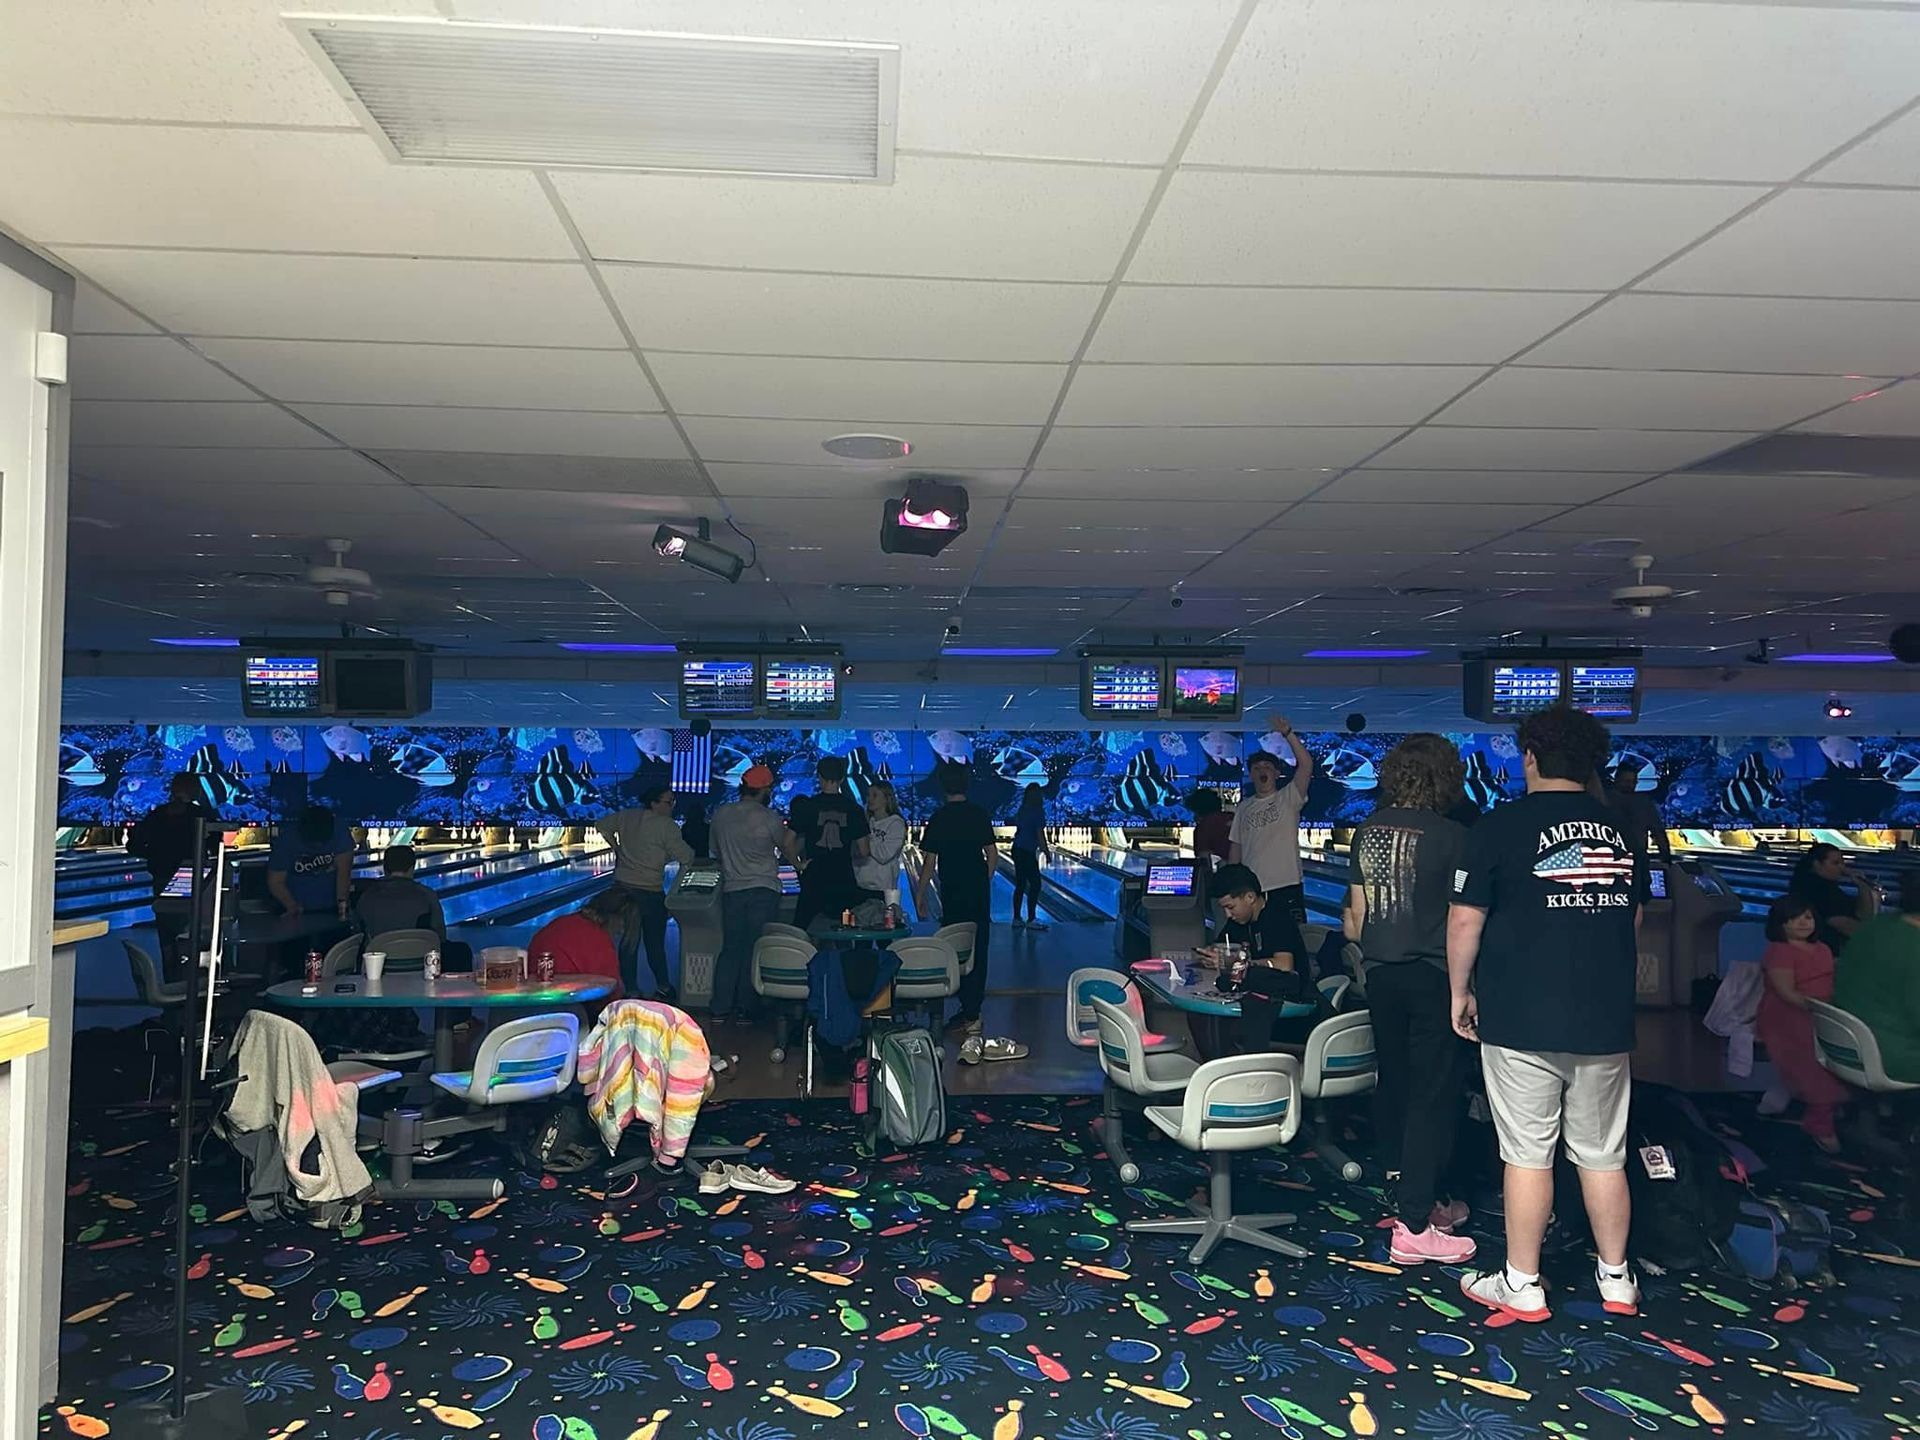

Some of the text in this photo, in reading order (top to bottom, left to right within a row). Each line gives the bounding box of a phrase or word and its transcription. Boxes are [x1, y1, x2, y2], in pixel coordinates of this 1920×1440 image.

[1198, 780, 1218, 788] VIGO
[1537, 821, 1627, 854] AMERICA
[294, 852, 336, 873] Dorito
[1546, 893, 1594, 908] KICKS
